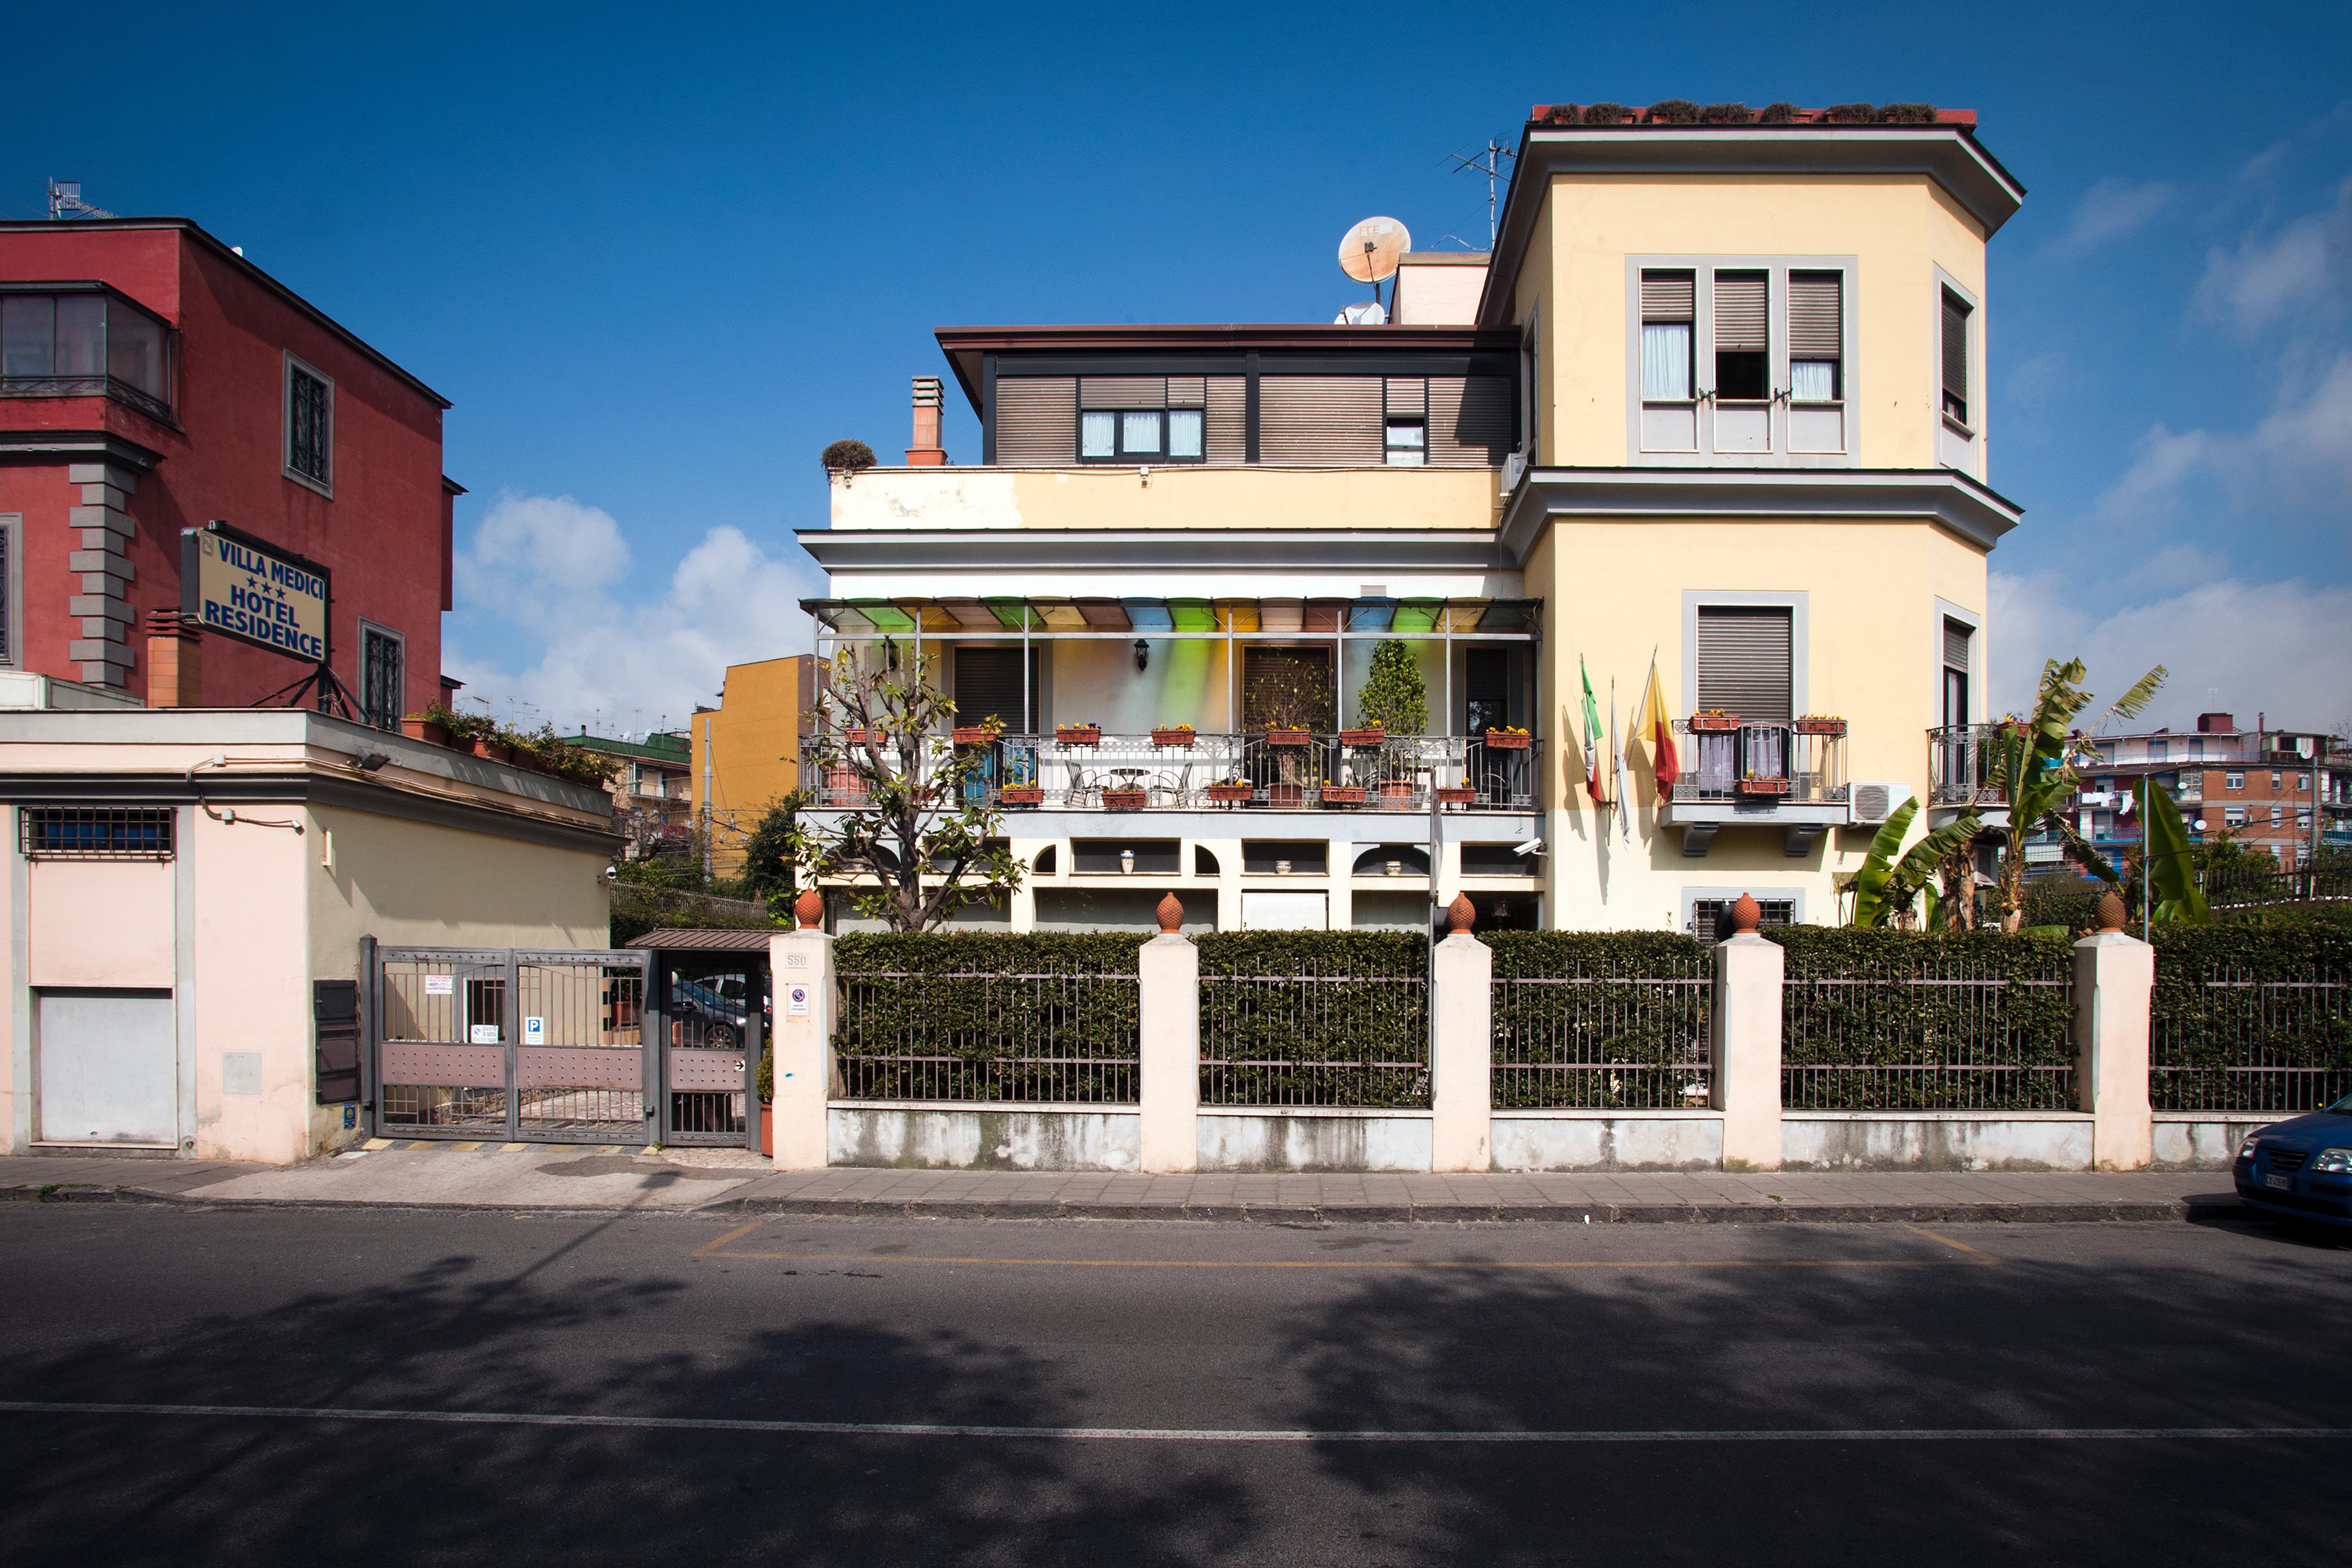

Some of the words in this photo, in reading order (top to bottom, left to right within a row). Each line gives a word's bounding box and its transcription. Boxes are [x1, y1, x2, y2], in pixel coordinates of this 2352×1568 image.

[218, 539, 267, 578] VILLA
[271, 560, 323, 600] MEDICI
[205, 599, 322, 658] RESIDENCE
[231, 585, 300, 629] HOTEL
[787, 955, 806, 965] 550
[530, 1020, 539, 1031] P
